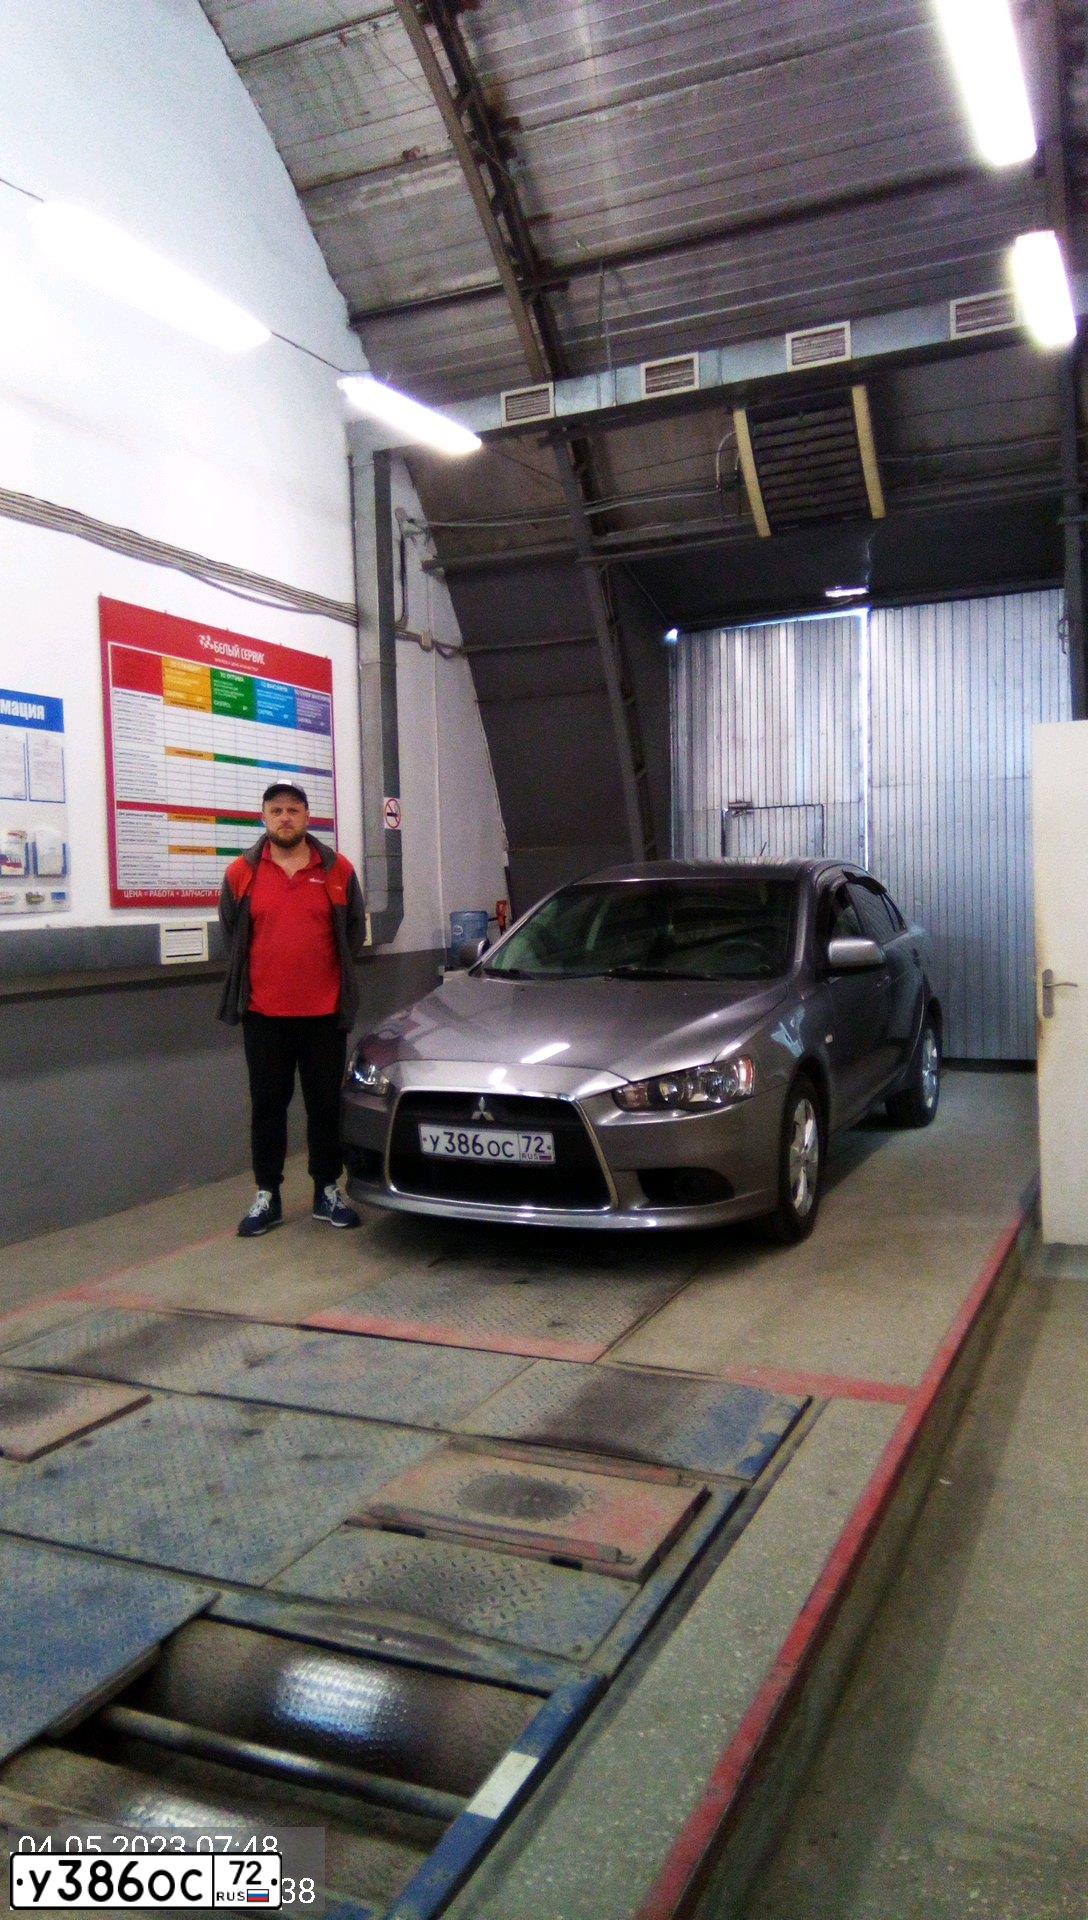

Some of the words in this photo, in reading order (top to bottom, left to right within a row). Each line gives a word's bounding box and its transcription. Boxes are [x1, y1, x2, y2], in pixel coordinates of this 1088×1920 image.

[213, 641, 240, 658] БЕЛЫЙ
[240, 648, 265, 665] СЕРВИС
[123, 890, 142, 899] ЦЕНА
[149, 889, 175, 898] РАБОТА
[429, 1131, 514, 1159] У386ОС
[521, 1135, 546, 1154] 72
